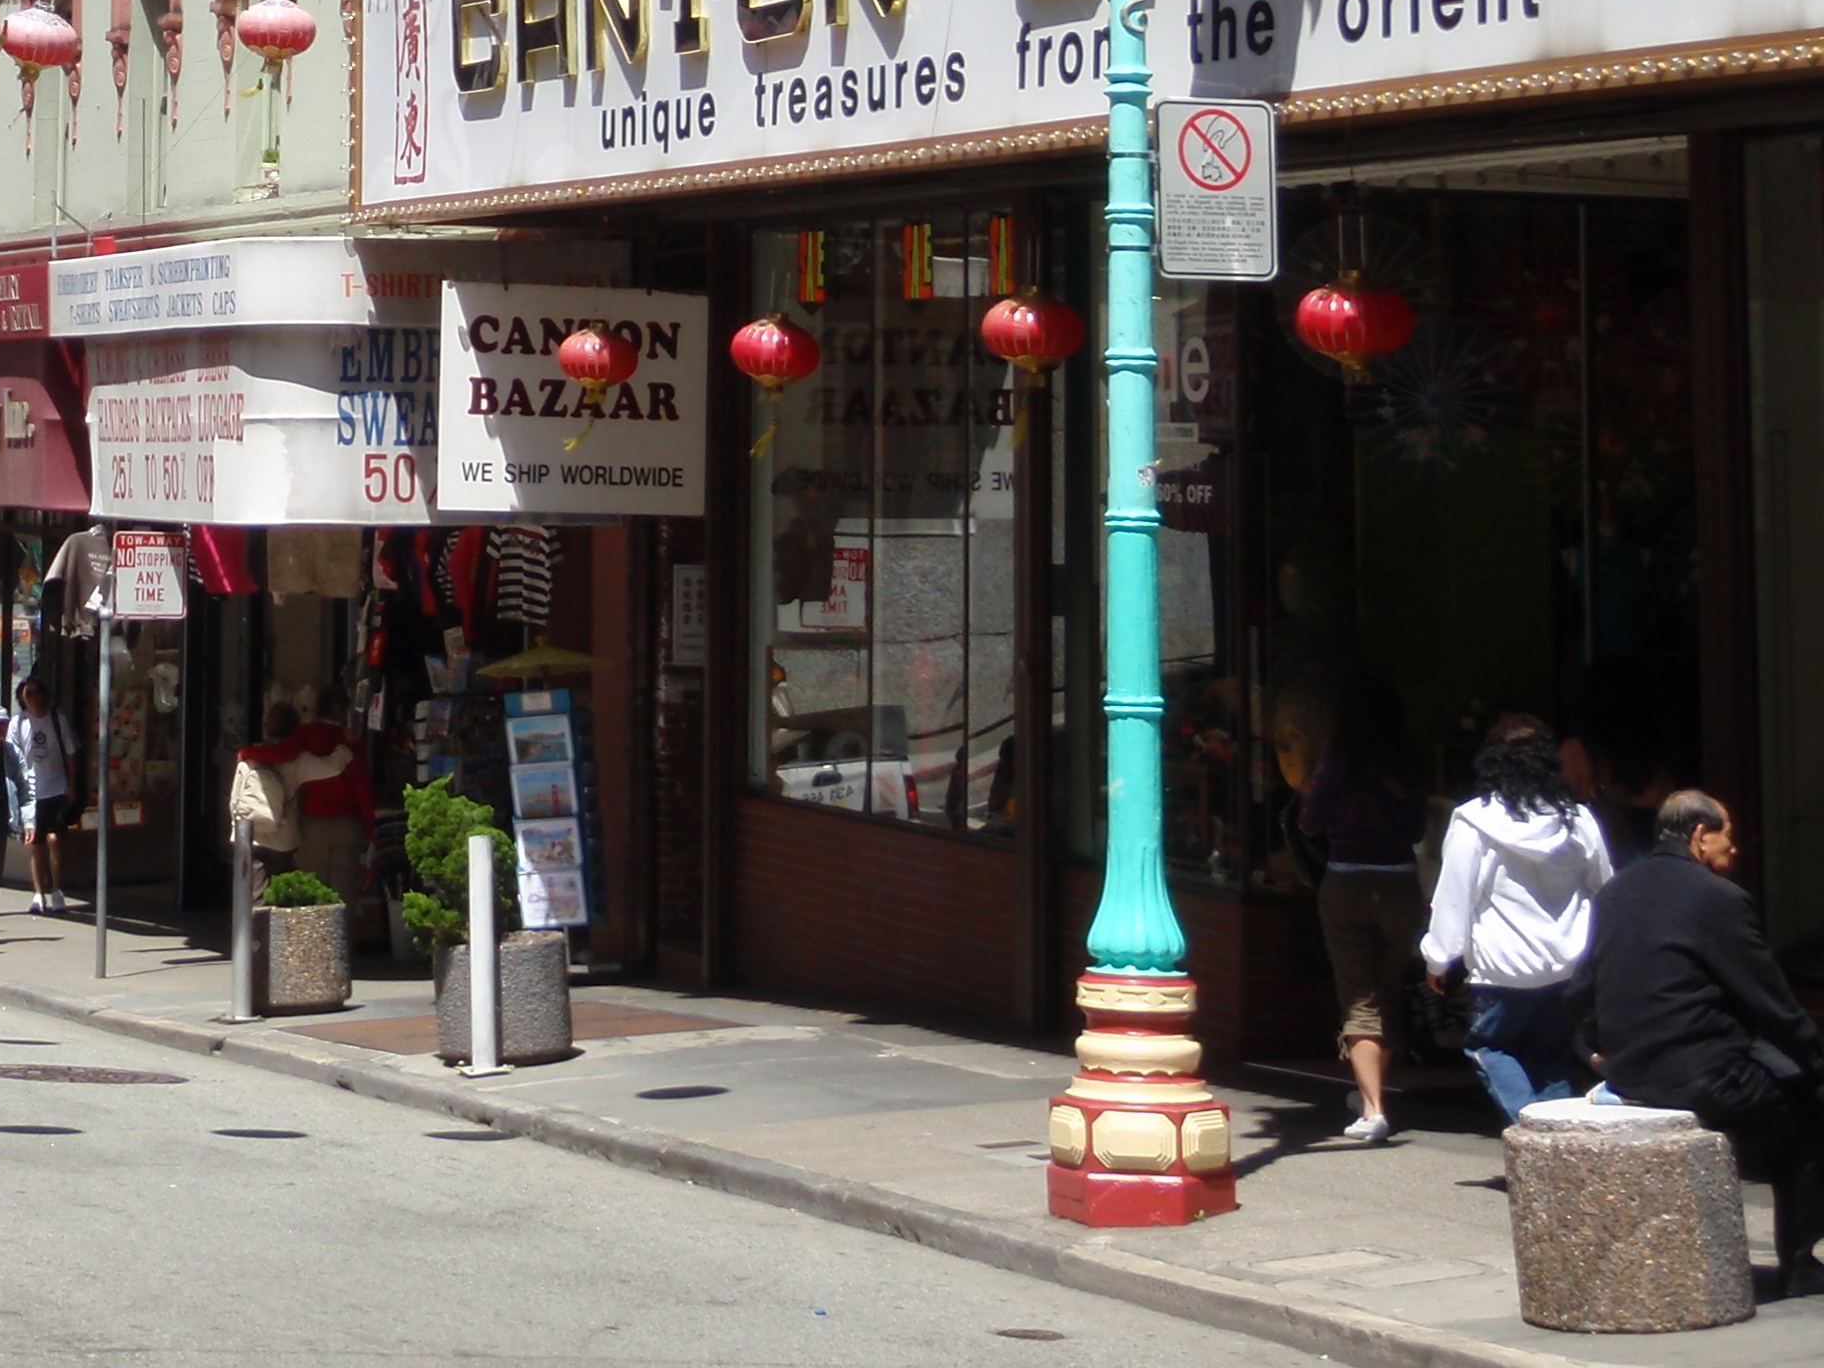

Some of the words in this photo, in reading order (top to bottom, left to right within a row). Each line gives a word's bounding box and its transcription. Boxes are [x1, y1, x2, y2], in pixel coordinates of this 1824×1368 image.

[600, 91, 717, 155] unique
[753, 50, 967, 129] treasures
[166, 291, 203, 318] JACKETS
[212, 290, 237, 316] CAPS
[468, 314, 681, 360] CANON
[198, 392, 245, 443] LUGGAGE
[336, 390, 438, 446] SWEA
[144, 453, 158, 500] TO
[461, 461, 494, 483] WE
[504, 462, 551, 484] SHIP
[560, 464, 684, 488] WORLDWIDE
[1186, 485, 1213, 504] OFF
[120, 535, 182, 546] TOW-AWAY
[117, 547, 135, 567] NO
[136, 552, 182, 567] STOPPING
[136, 570, 163, 585] ANY
[134, 587, 165, 602] TIME
